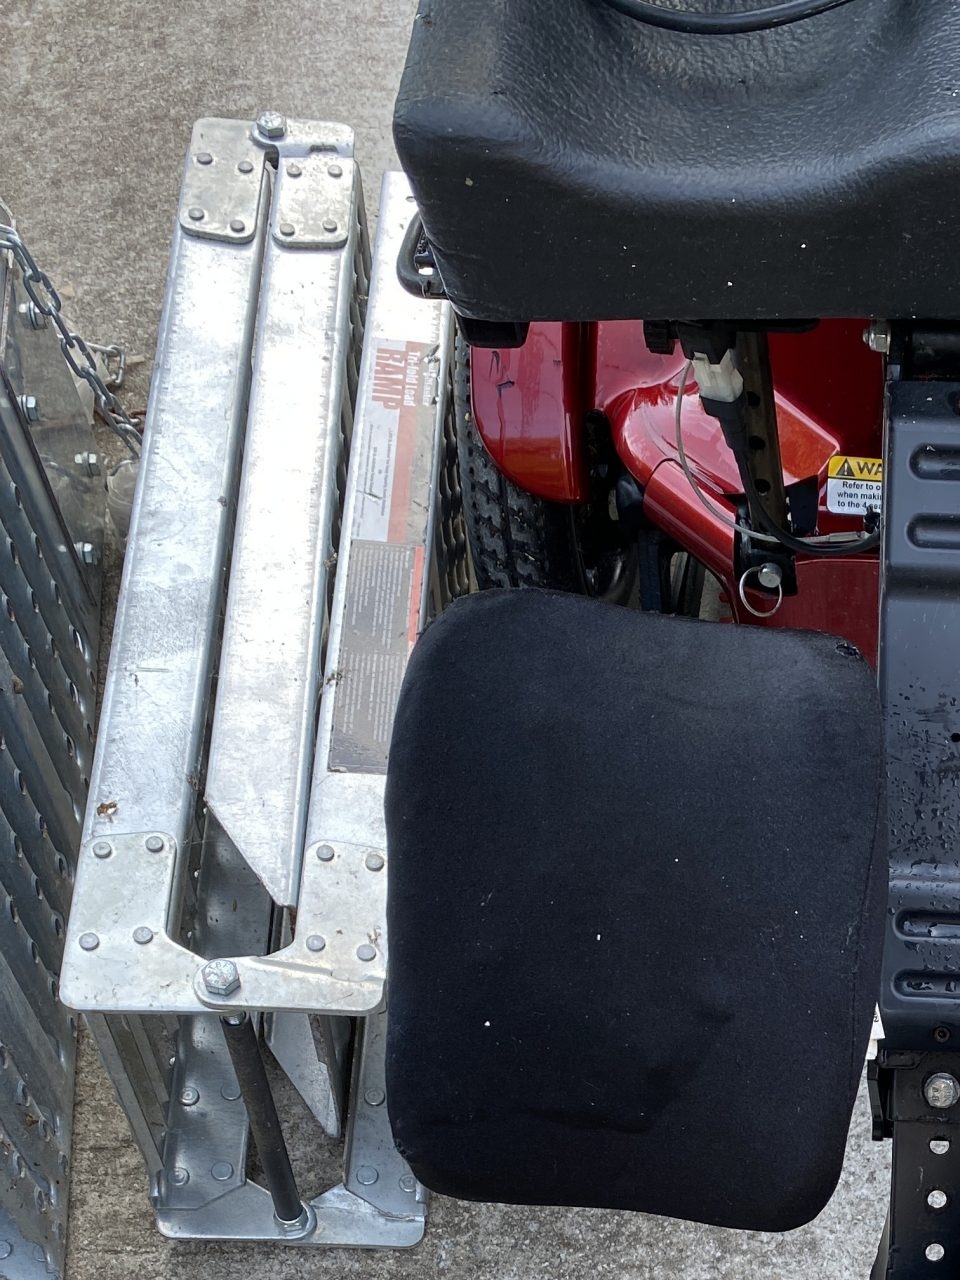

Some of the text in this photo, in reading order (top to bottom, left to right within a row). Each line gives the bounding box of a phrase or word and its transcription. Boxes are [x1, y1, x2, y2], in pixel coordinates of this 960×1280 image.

[371, 348, 405, 410] RAMP
[404, 385, 417, 407] Load
[842, 481, 863, 490] Refer
[837, 491, 858, 499] when
[847, 501, 860, 509] the
